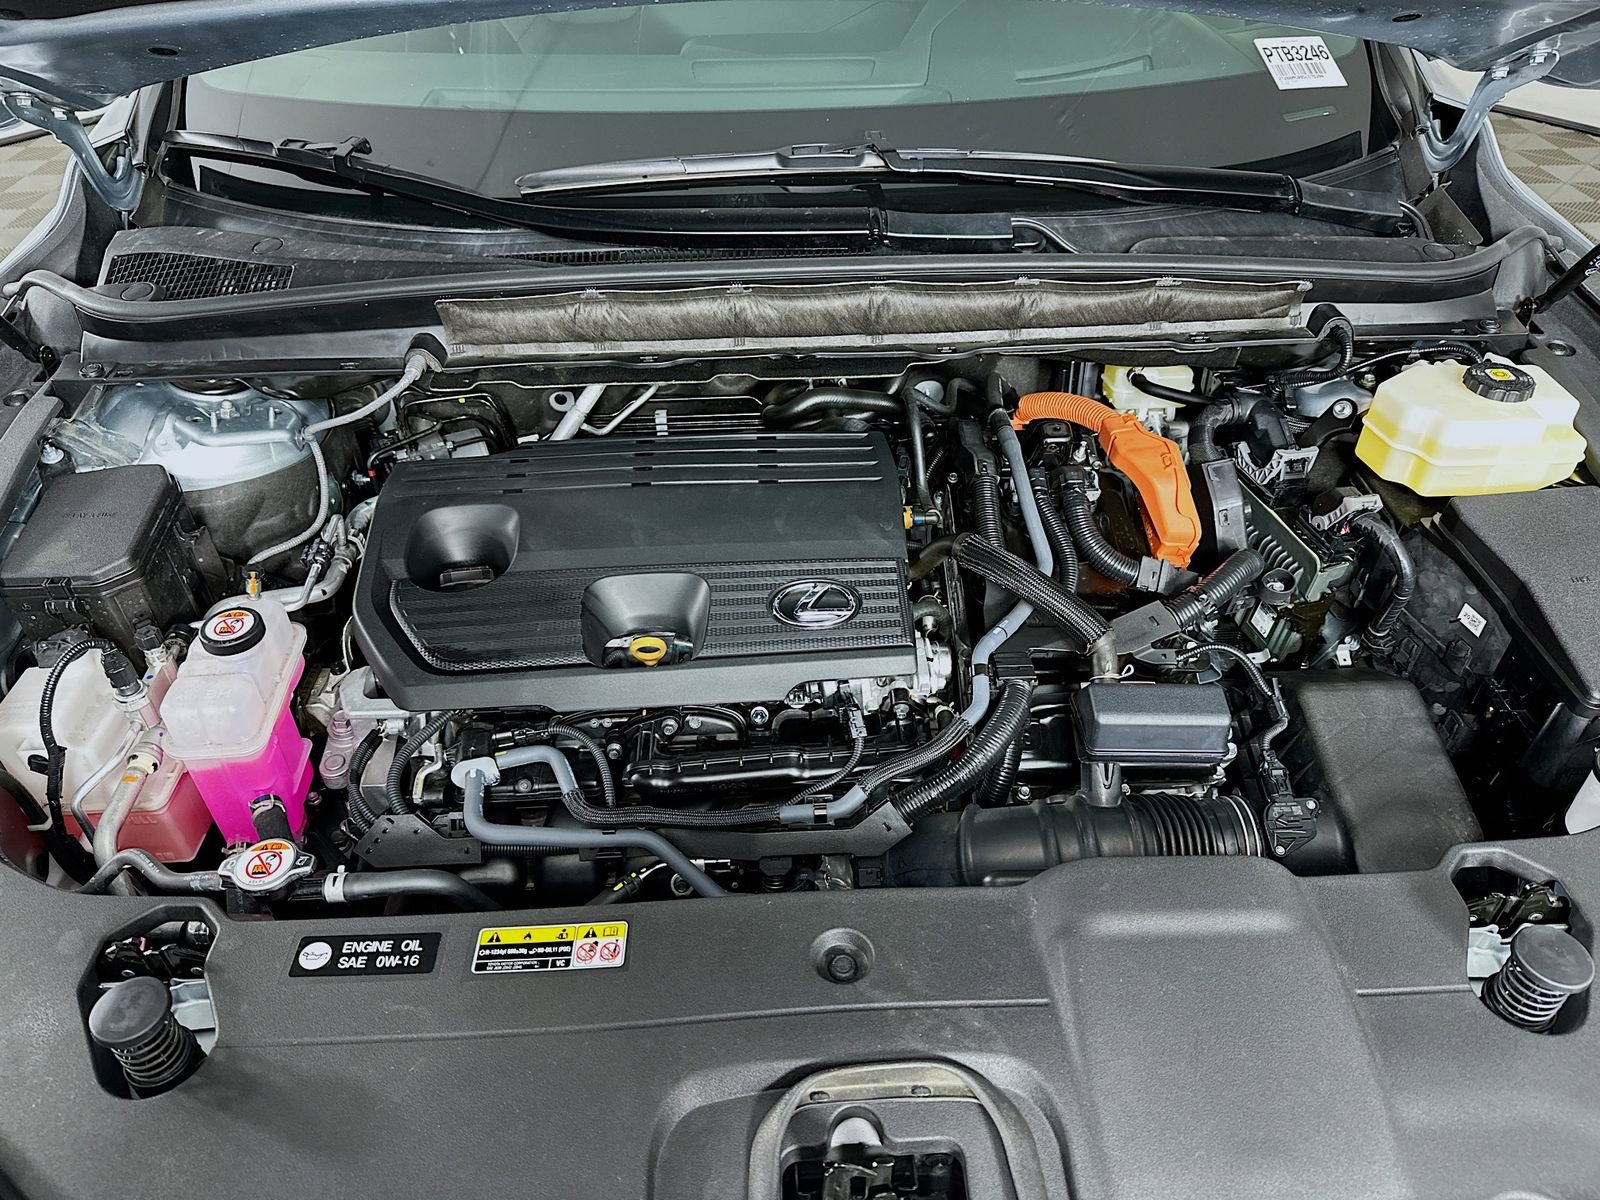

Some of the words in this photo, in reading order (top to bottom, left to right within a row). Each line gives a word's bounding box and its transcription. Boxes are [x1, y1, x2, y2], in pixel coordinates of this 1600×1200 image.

[1262, 44, 1329, 63] PTB3246
[342, 940, 394, 954] ENGINE
[401, 939, 423, 952] OIL
[338, 956, 368, 969] SAE
[375, 954, 420, 968] 0W-16
